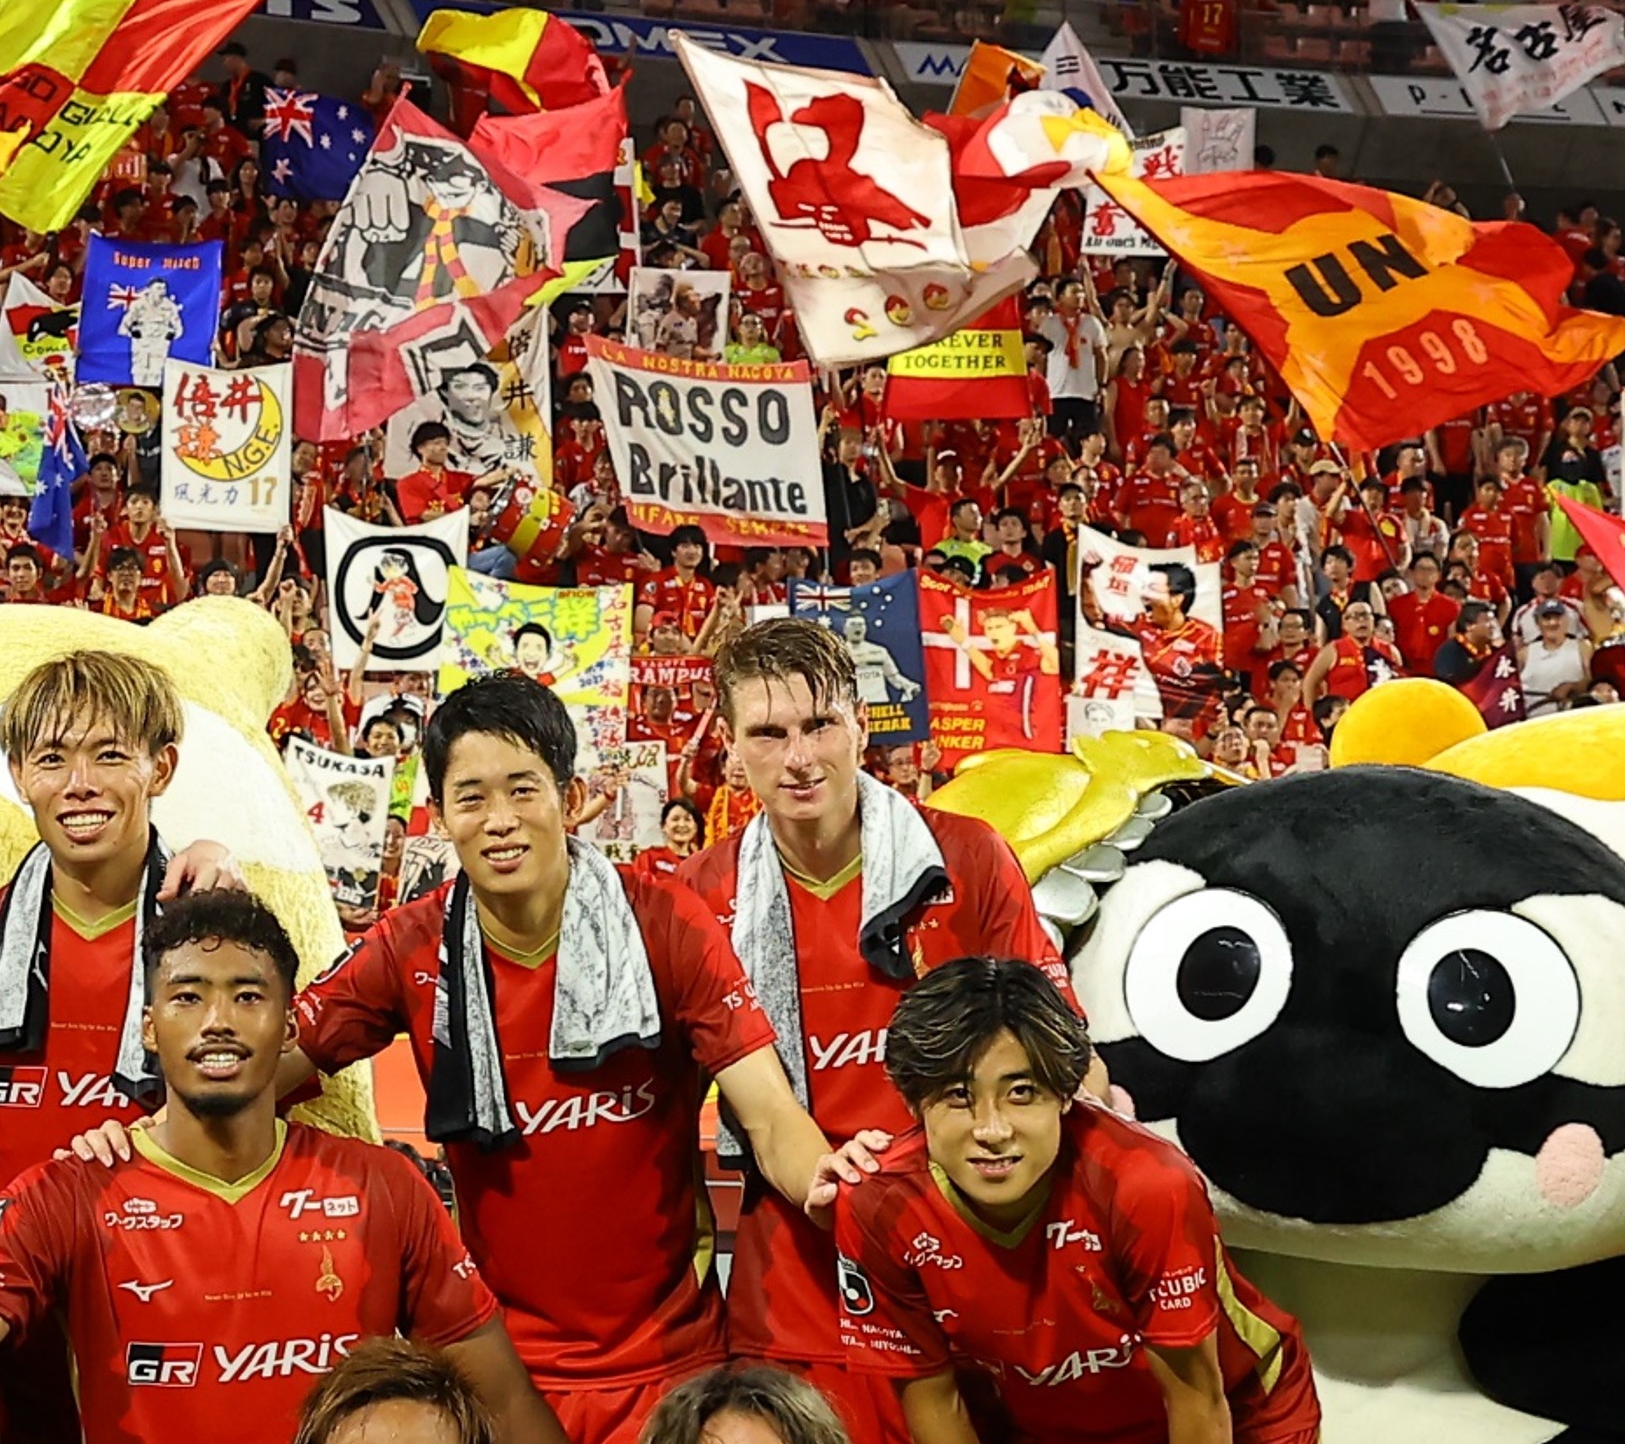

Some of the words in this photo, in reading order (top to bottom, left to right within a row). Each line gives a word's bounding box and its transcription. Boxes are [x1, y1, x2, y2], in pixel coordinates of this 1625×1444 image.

[1110, 61, 1340, 110] 万能工業
[1285, 234, 1428, 318] UN
[643, 357, 718, 378] NOSTRA
[727, 363, 794, 380] NAGOYA
[904, 354, 1006, 369] TOGETHER
[1363, 319, 1489, 401] 1998
[172, 373, 264, 423] 倍井
[612, 375, 790, 448] ROSSO
[223, 423, 279, 478] N.G.E.
[627, 442, 808, 514] Brillante
[249, 479, 277, 506] 17
[629, 666, 713, 684] RAMPUS
[929, 716, 986, 733] ASPER
[936, 735, 986, 750] NKER
[294, 744, 385, 779] TSUKASA
[306, 802, 325, 823] 4
[104, 1213, 184, 1231] ワークスタッフ
[1159, 1297, 1192, 1311] CARD
[128, 1358, 197, 1385] GR
